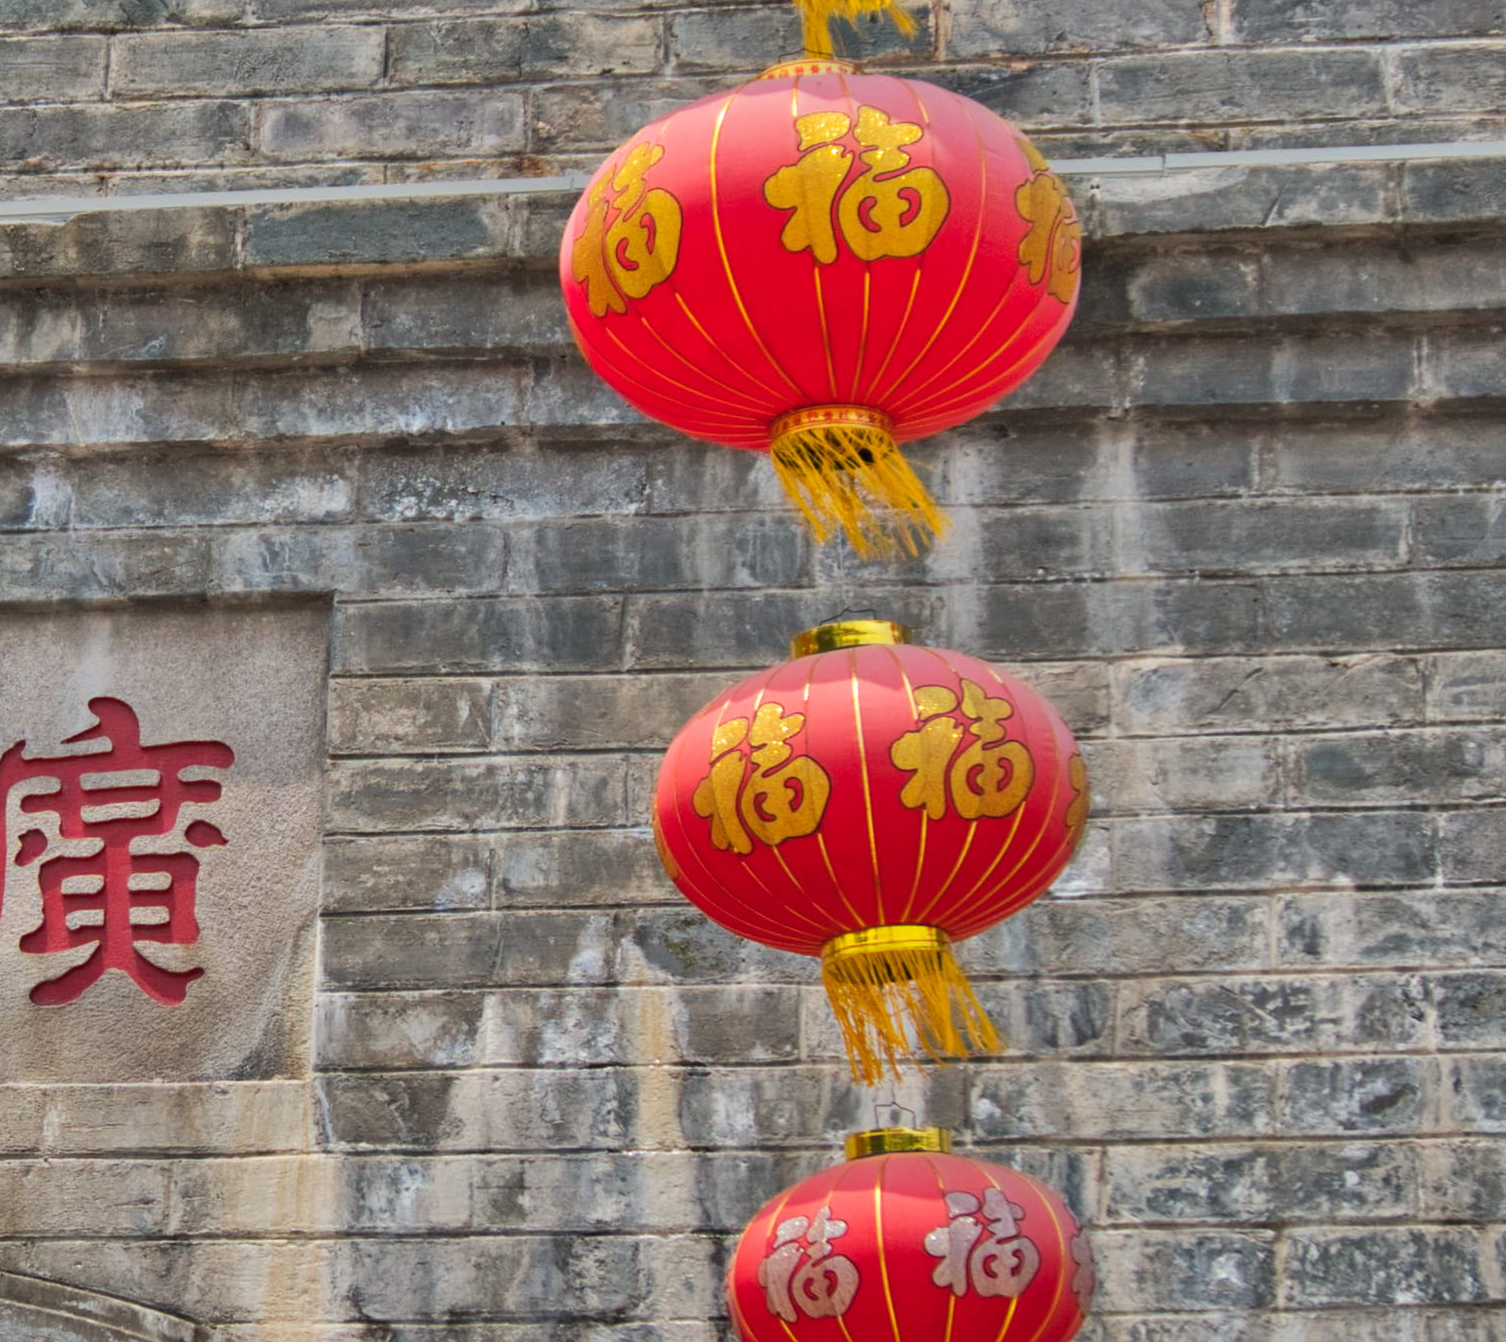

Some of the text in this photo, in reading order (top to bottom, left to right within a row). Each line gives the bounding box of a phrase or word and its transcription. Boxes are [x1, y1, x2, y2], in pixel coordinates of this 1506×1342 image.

[572, 141, 683, 317] 福
[763, 104, 951, 265] 福
[693, 702, 831, 854] 福
[890, 678, 1035, 820] 福
[758, 1206, 861, 1323] 福
[924, 1187, 1040, 1297] 福
